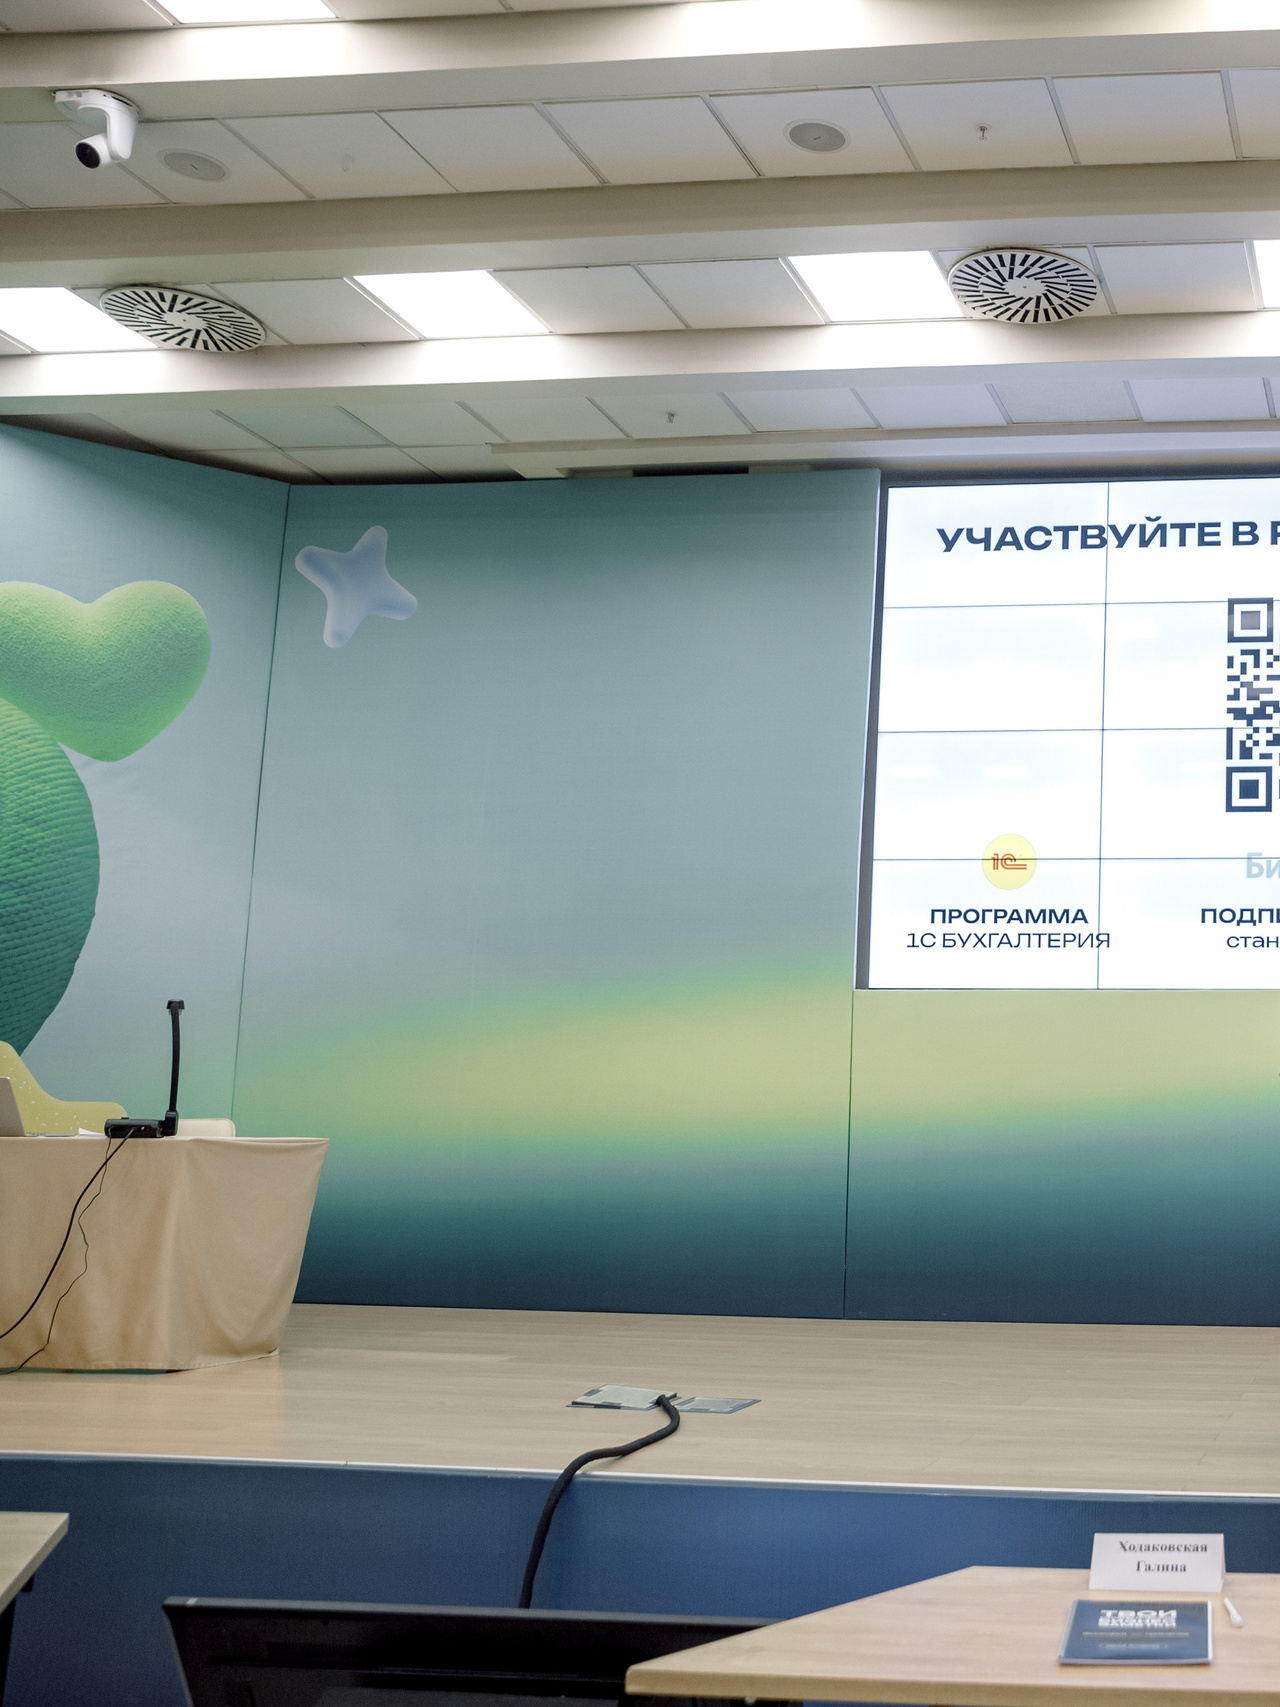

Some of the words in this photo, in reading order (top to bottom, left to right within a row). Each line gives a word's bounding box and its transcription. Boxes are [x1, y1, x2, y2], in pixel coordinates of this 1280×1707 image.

[936, 515, 1222, 553] УЧАСТВУЙТЕ
[1232, 521, 1260, 547] В
[929, 908, 1089, 925] ПРОГРАММА
[942, 932, 1111, 949] БУХГАЛТЕРИЯ
[1118, 1540, 1209, 1554] Ходаковская
[1135, 1560, 1188, 1574] Галина
